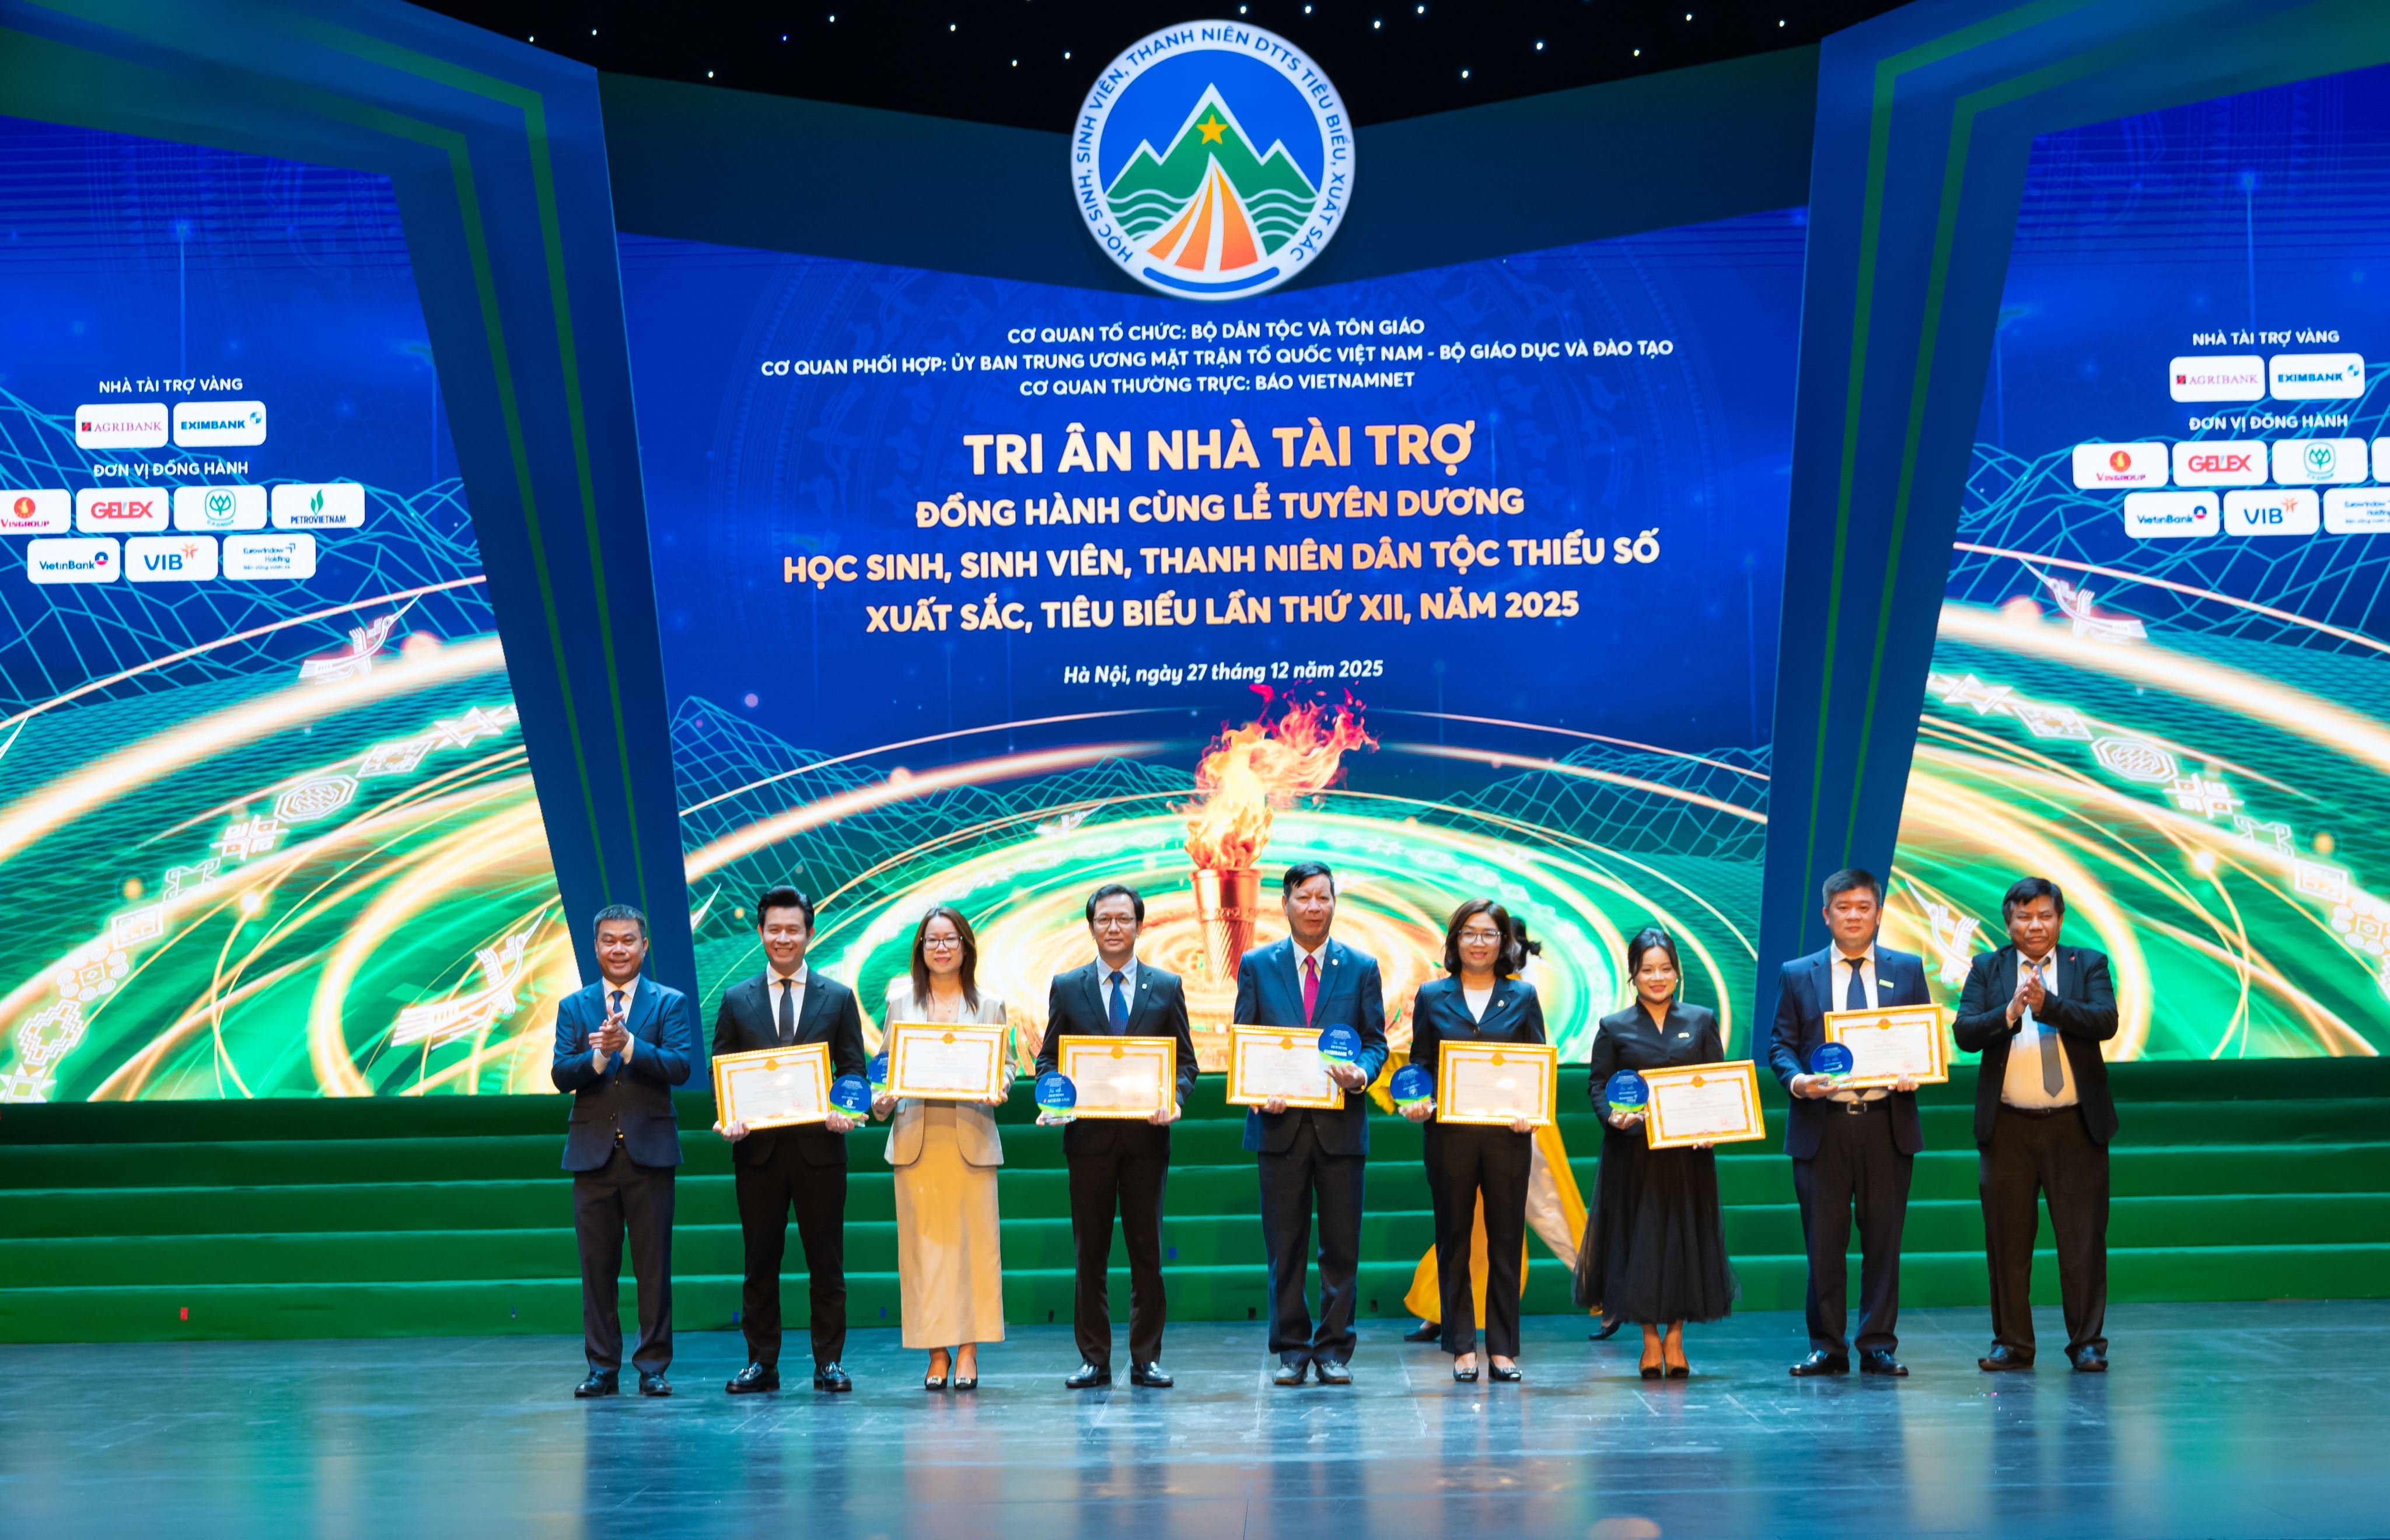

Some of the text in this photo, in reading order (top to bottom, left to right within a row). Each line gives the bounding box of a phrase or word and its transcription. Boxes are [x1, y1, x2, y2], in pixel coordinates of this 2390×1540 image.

[1126, 29, 1194, 66] THANH
[1201, 25, 1250, 46] NIÊN
[1255, 36, 1302, 71] DTTS
[1088, 68, 1130, 108] VIÊN,
[1301, 67, 1334, 110] TIÊU
[1077, 115, 1098, 164] SINH
[1078, 169, 1103, 222] SINH,
[1319, 171, 1346, 226] XUẤT
[1098, 223, 1134, 263] HỌC
[1290, 225, 1323, 262] SẮC
[1008, 317, 1425, 344] CƠ QUAN TỔ CHỨC: BỘ DÂN TỘC VÀ TÔN GIÁO
[2193, 327, 2340, 348] NHÀ TÀI TRỢ VÀNG
[761, 360, 790, 376] CƠ
[794, 359, 848, 375] QUAN
[852, 354, 897, 373] PHỐI
[902, 356, 946, 376] HỢP:
[952, 353, 976, 371] ỦY
[980, 355, 1018, 370] BAN
[1022, 354, 1085, 369] TRUNG
[1089, 352, 1147, 368] ƯƠNG
[1151, 349, 1189, 370] MẶT
[1193, 347, 1242, 369] TRẬN
[1247, 345, 1271, 363] TỔ
[1276, 344, 1332, 363] QUỐC
[1337, 344, 1376, 365] VIỆT
[1381, 345, 1423, 361] NAM
[1439, 342, 1466, 363] BỘ
[1470, 341, 1517, 359] GIÁO
[1521, 342, 1560, 361] DỤC
[1564, 340, 1588, 356] VÀ
[1593, 338, 1633, 356] ĐÀO
[1637, 340, 1673, 359] TẠO
[99, 375, 243, 394] NHÀ TÀI TRỢ VÀNG
[1019, 372, 1415, 396] CƠ QUAN THƯỜNG TRỰC: BÁO VIETNAMNET
[2189, 374, 2258, 385] AGRIBANK
[2277, 373, 2343, 383] EXIMBANK
[94, 422, 162, 432] AGRIBANK
[181, 419, 246, 430] EXIMBANK
[2189, 417, 2226, 430] ĐƠN
[2230, 417, 2246, 433] VỊ
[2302, 411, 2347, 427] HÀNH
[963, 416, 1476, 476] TRI ÂN NHÀ TÀI TRỢ
[93, 459, 248, 480] ĐƠN VỊ ĐỒNG HÀNH
[2188, 454, 2251, 473] GELEX
[90, 501, 153, 519] GELEX
[915, 482, 1525, 528] ĐỒNG HÀNH CÙNG LỄ TUYÊN DƯƠNG
[2244, 508, 2283, 525] VIB
[291, 515, 346, 524] PETROVIETNAM
[2137, 514, 2193, 524] VietinBank
[39, 559, 95, 570] VietinBank
[144, 554, 183, 571] VIB
[784, 527, 1660, 590] HỌC SINH, SINH VIÊN, THANH NIÊN DÂN TỘC THIẾU SỐ
[866, 586, 1580, 634] XUẤT SẮC, TIÊU BIỂU LẦN THỨ XII, NĂM 2025
[1064, 660, 1383, 687] Hà Nội, ngày 27 tháng 12 năm 2025
